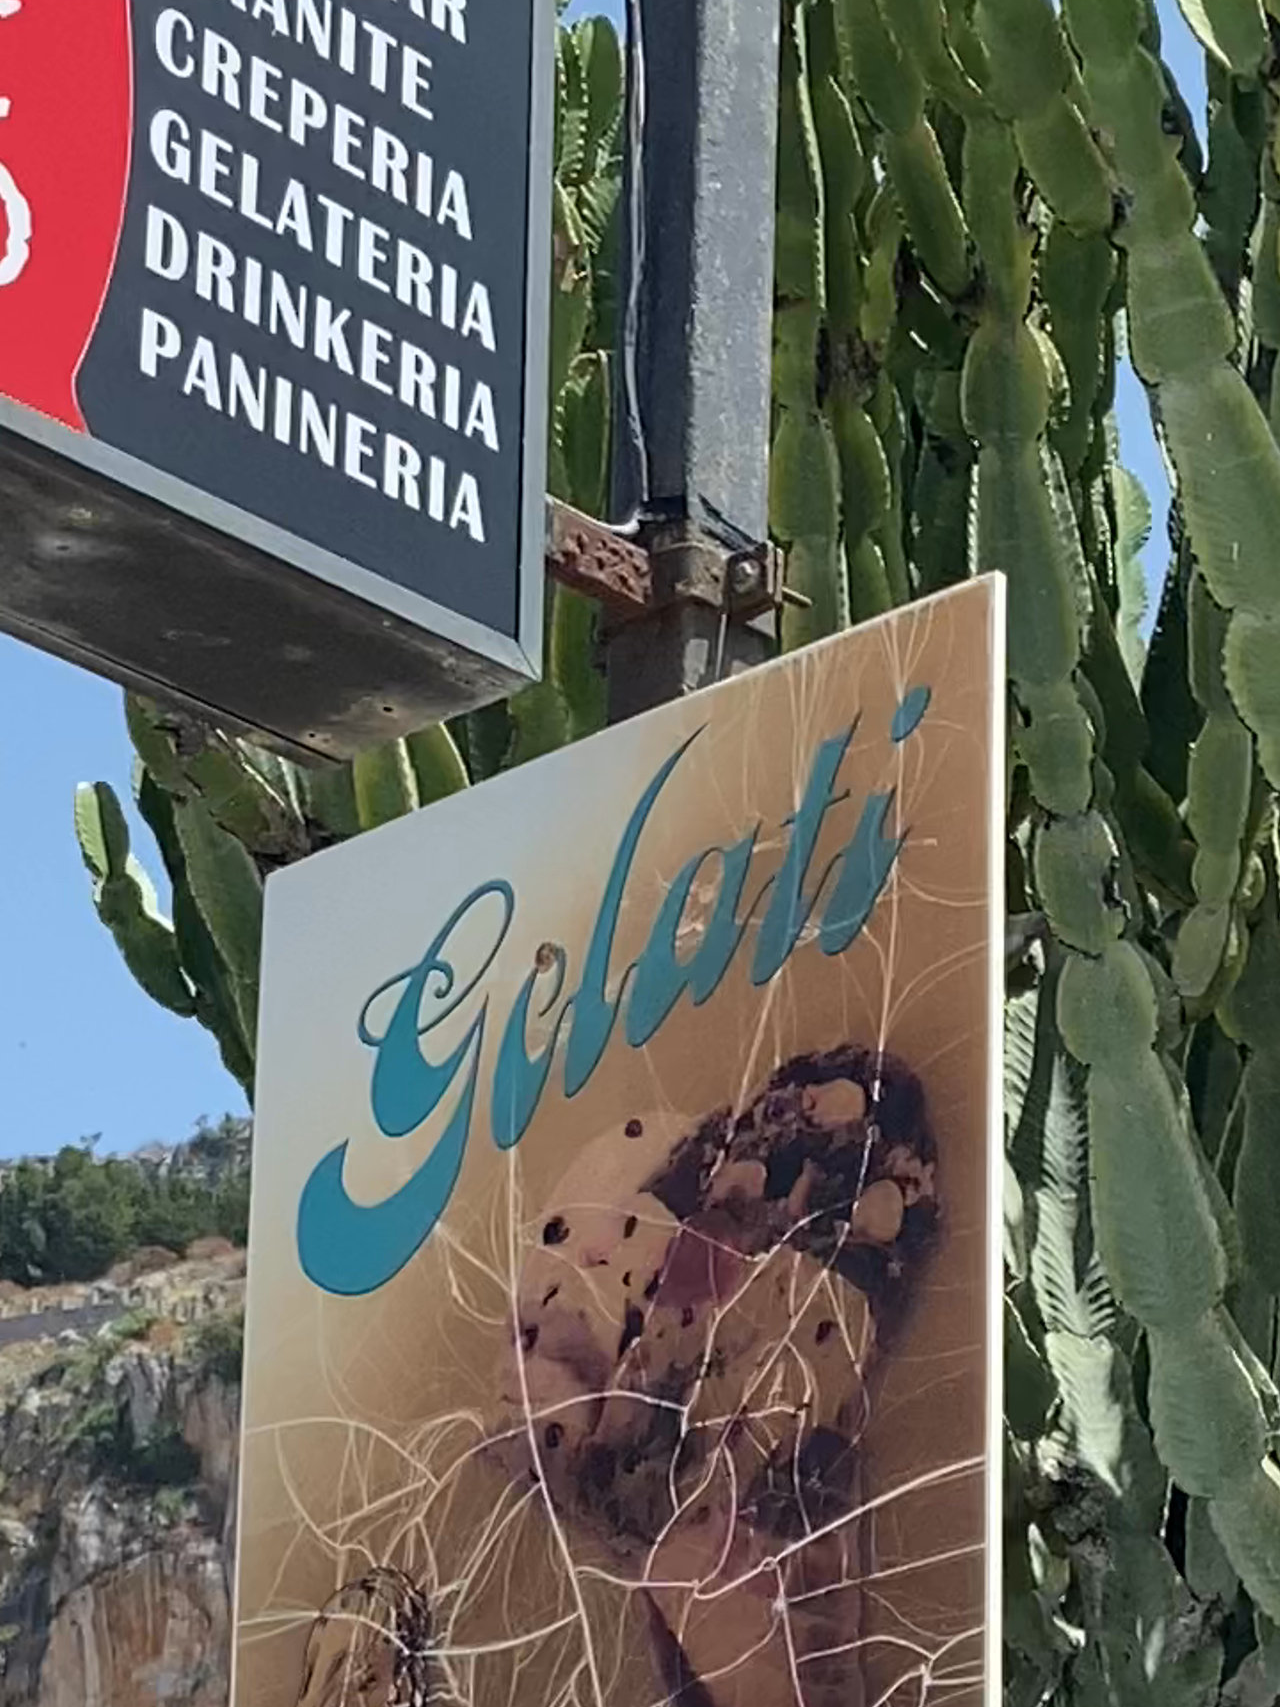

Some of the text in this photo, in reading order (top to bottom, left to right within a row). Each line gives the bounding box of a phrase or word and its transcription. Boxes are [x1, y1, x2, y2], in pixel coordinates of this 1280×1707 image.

[149, 108, 497, 352] GELATERIA
[154, 7, 473, 241] CREPERIA
[139, 307, 486, 543] PANINERIA
[144, 204, 500, 453] DRINKERIA
[296, 684, 933, 1296] Gelati
